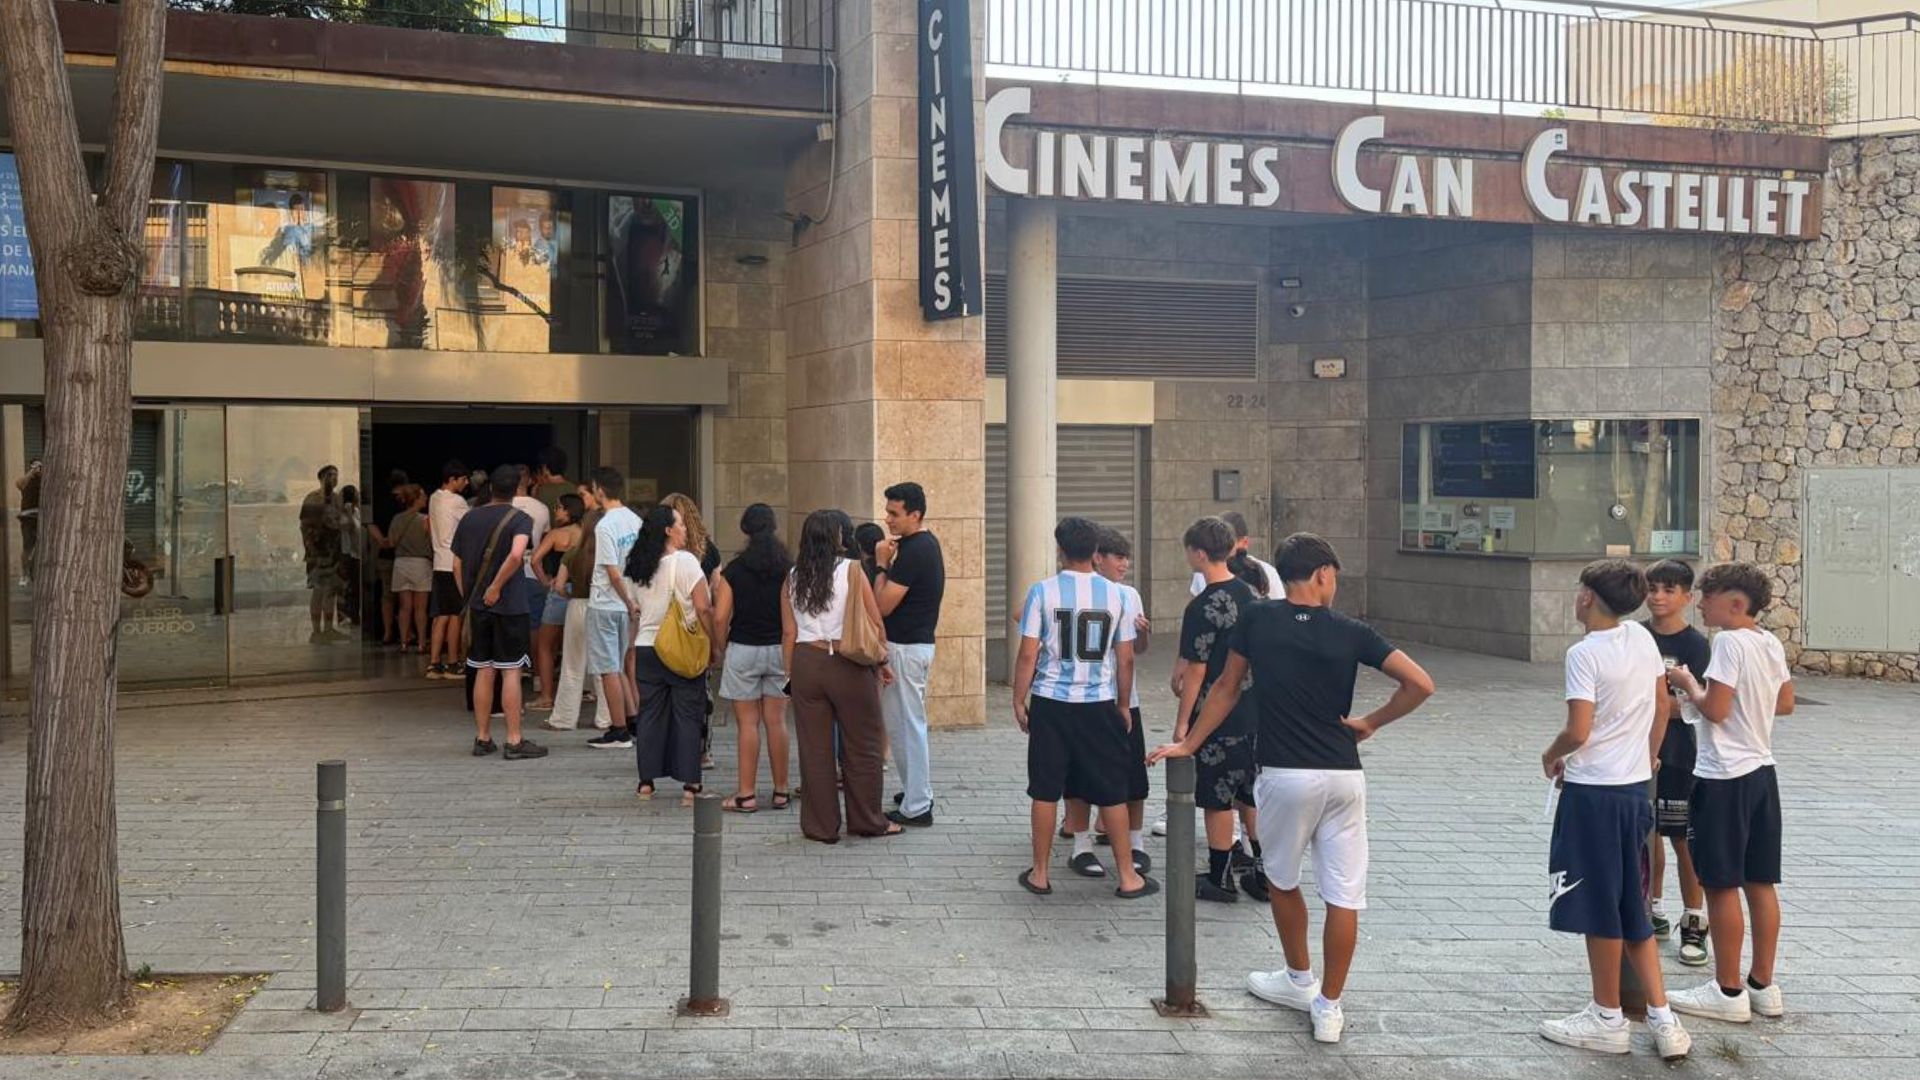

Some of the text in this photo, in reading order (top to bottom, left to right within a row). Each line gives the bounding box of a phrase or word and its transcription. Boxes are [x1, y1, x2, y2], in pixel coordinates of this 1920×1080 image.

[928, 9, 951, 311] CINEMES
[985, 87, 1809, 236] CINEMES CAN CASTELLET
[1054, 607, 1114, 662] 10
